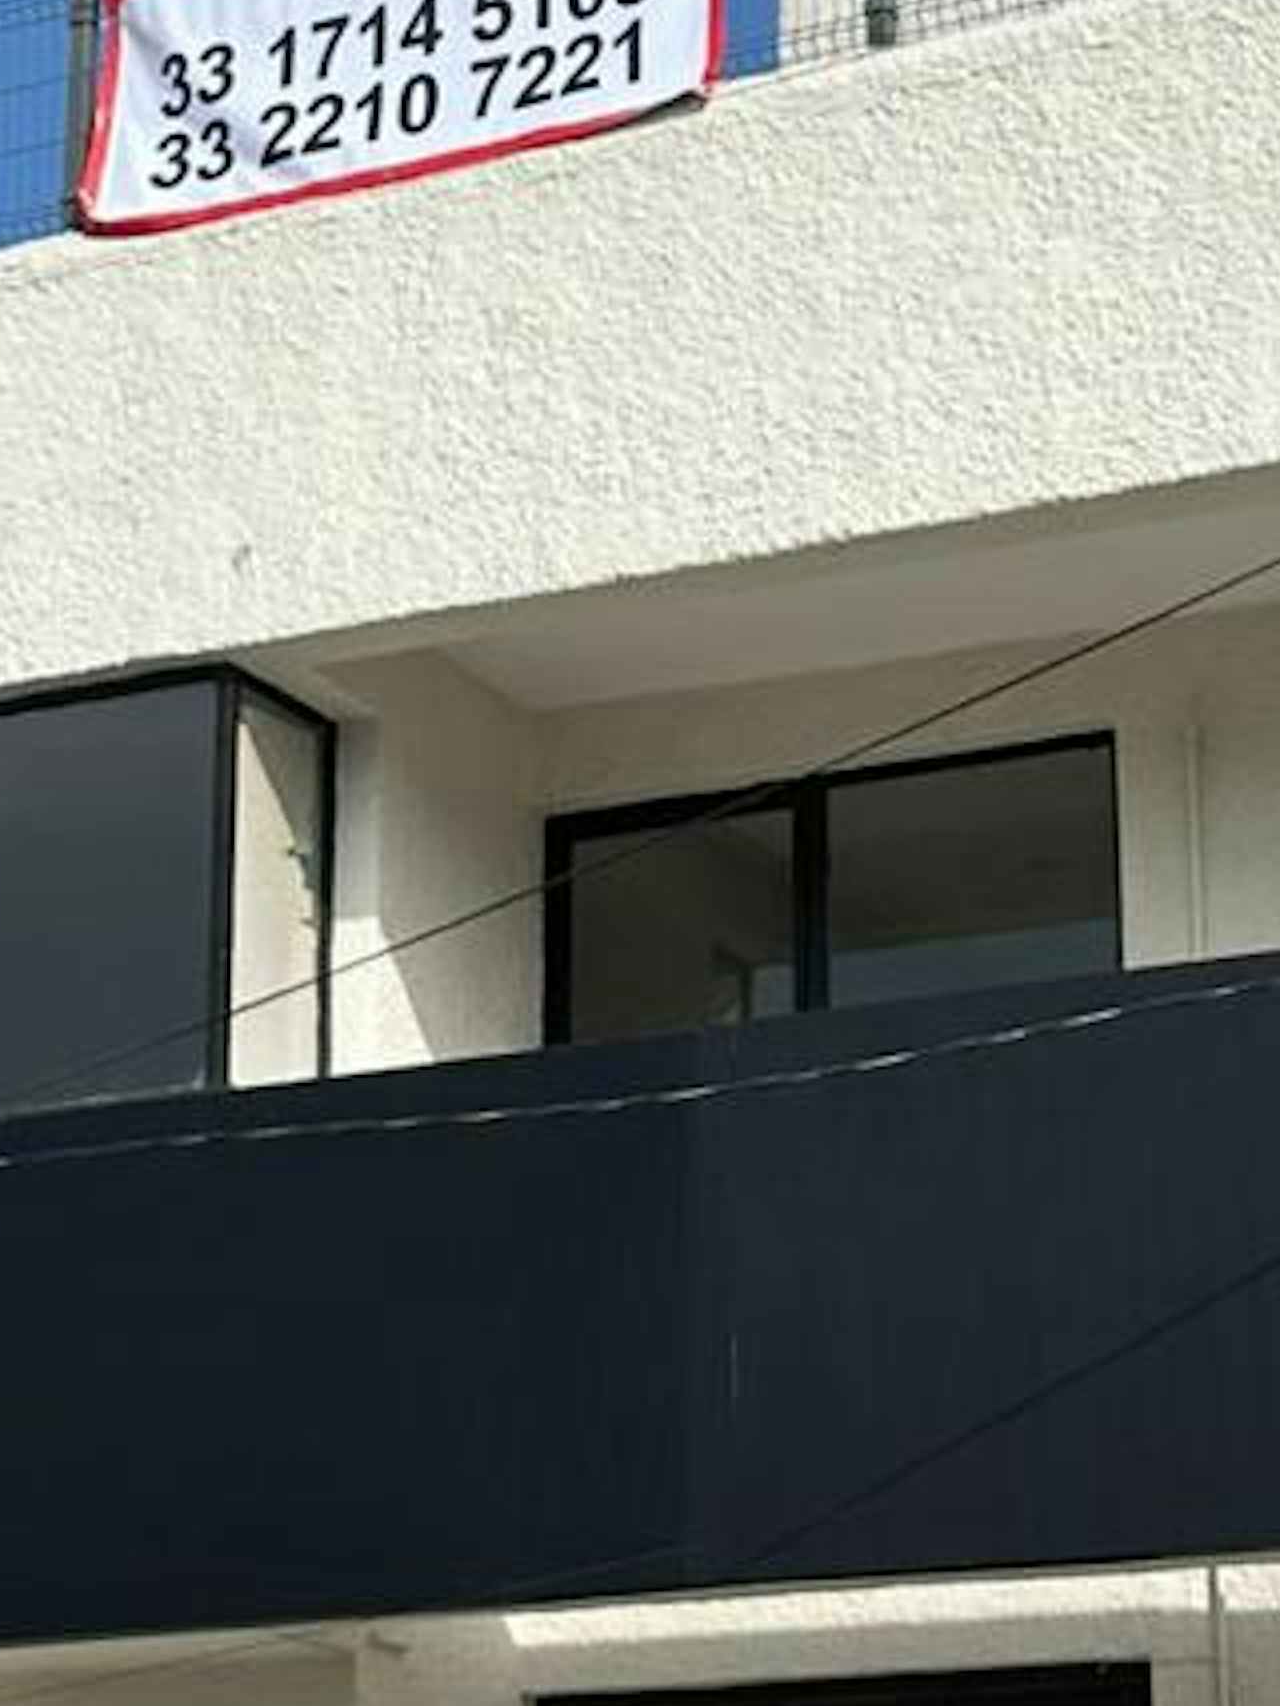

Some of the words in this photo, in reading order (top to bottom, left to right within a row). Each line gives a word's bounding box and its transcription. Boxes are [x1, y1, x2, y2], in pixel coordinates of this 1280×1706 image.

[150, 120, 233, 189] 33
[259, 74, 438, 168] 2210
[470, 19, 644, 119] 7221
[160, 45, 235, 117] 33
